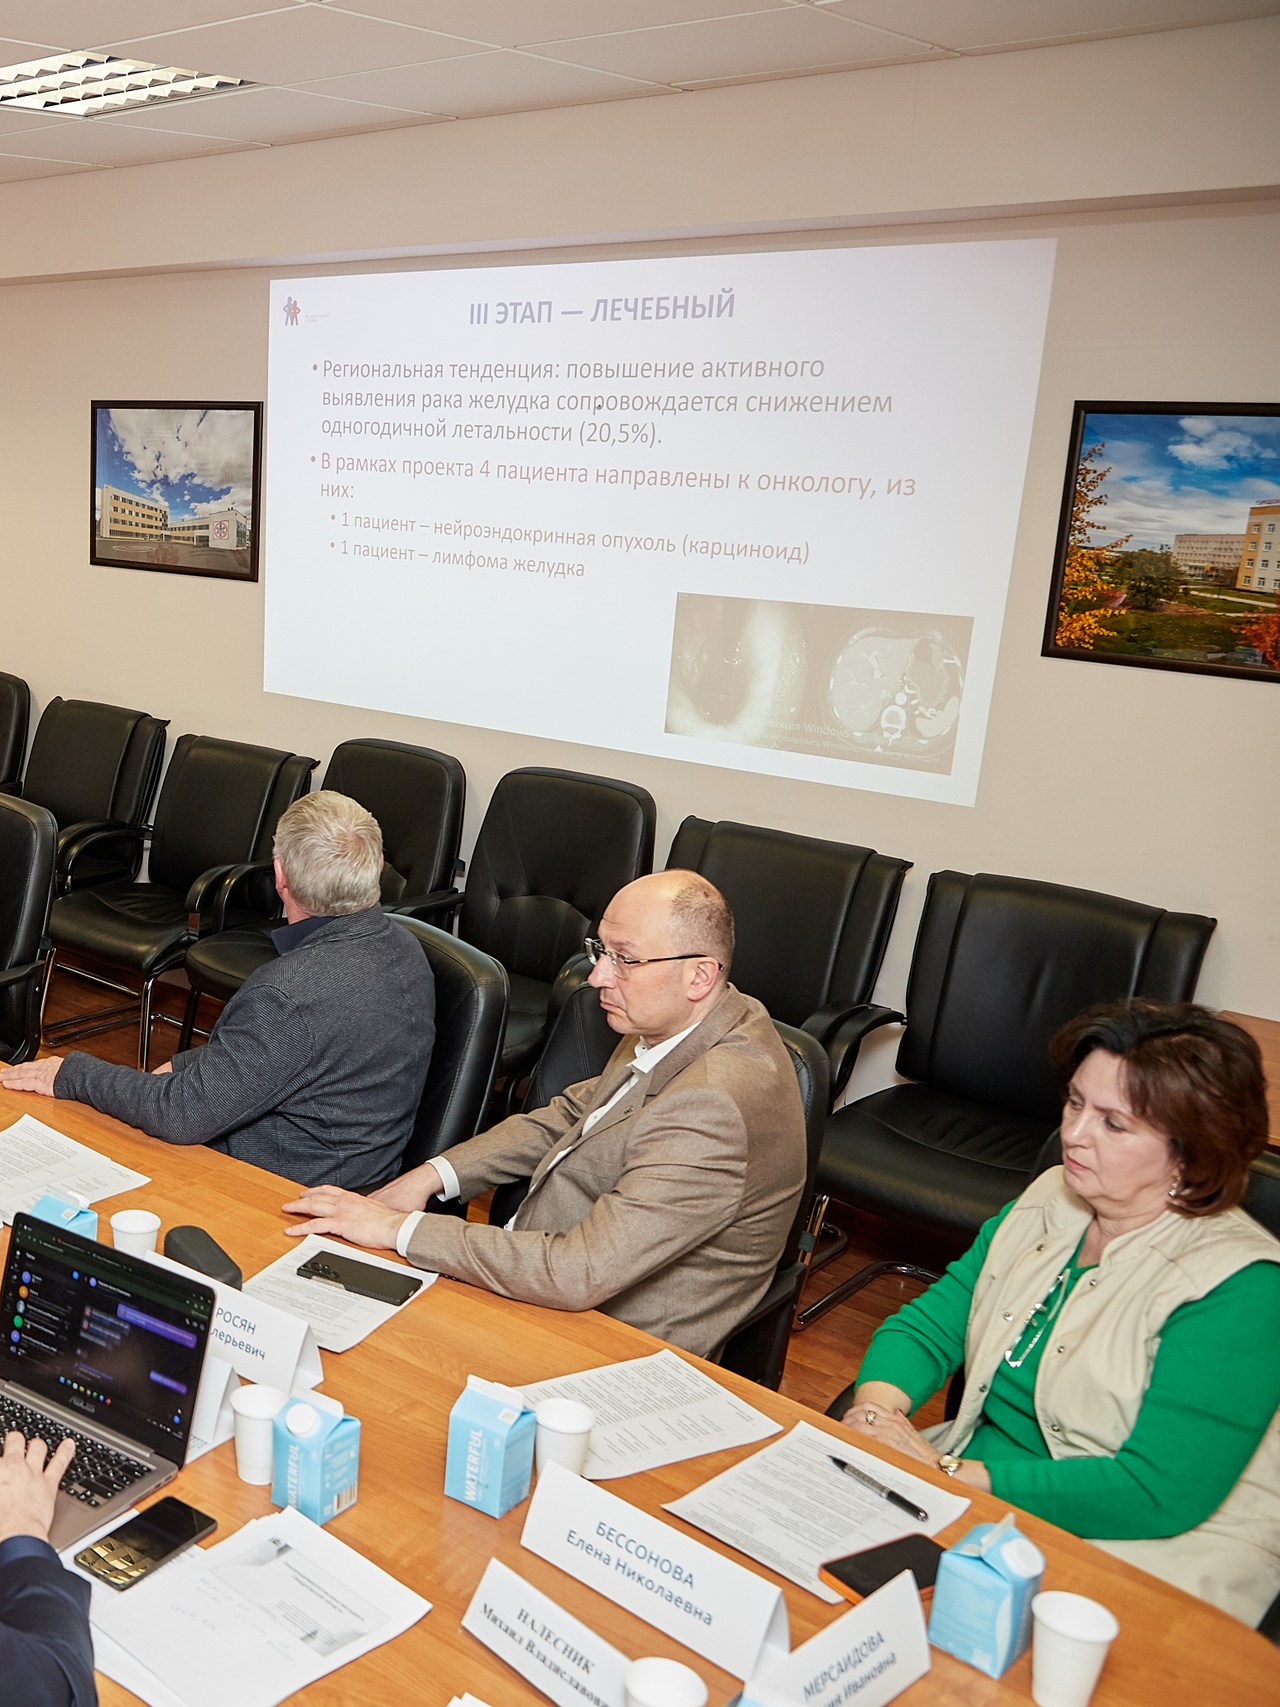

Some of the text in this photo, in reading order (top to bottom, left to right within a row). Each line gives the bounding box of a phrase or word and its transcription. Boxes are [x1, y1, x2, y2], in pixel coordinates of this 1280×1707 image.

[470, 303, 488, 325] III
[495, 301, 552, 324] ЭТАП
[590, 287, 735, 322] ЛЕЧЕБНЫЙ
[324, 360, 824, 383] Региональная тенденция: повышение активного
[323, 392, 892, 416] выявления рака желудка сопровождается снижением
[322, 418, 661, 448] одногодичной летальности (20,5%).
[321, 484, 354, 498] них:
[322, 452, 915, 499] В рамках проекта 4 пациента направлены к онкологу, из
[341, 540, 348, 554] 1
[354, 544, 415, 561] пациент
[432, 550, 507, 570] лимфома
[513, 559, 584, 579] желудка
[342, 512, 349, 527] 1
[355, 516, 416, 533] пациент
[434, 519, 595, 546] нейроэндокринная
[602, 534, 676, 553] опухоль
[683, 534, 809, 565] (карциноид)
[215, 1305, 257, 1336] РОСЯН
[210, 1328, 266, 1361] лерьевич
[464, 1430, 483, 1502] WATERFUL
[596, 1522, 693, 1588] БЕССОНОВА
[567, 1530, 712, 1625] Елена Николаевна
[516, 1608, 595, 1674] НАЛЕСНИК
[803, 1631, 885, 1700] МЕРСАИДОВА
[844, 1652, 896, 1699] Ивановна
